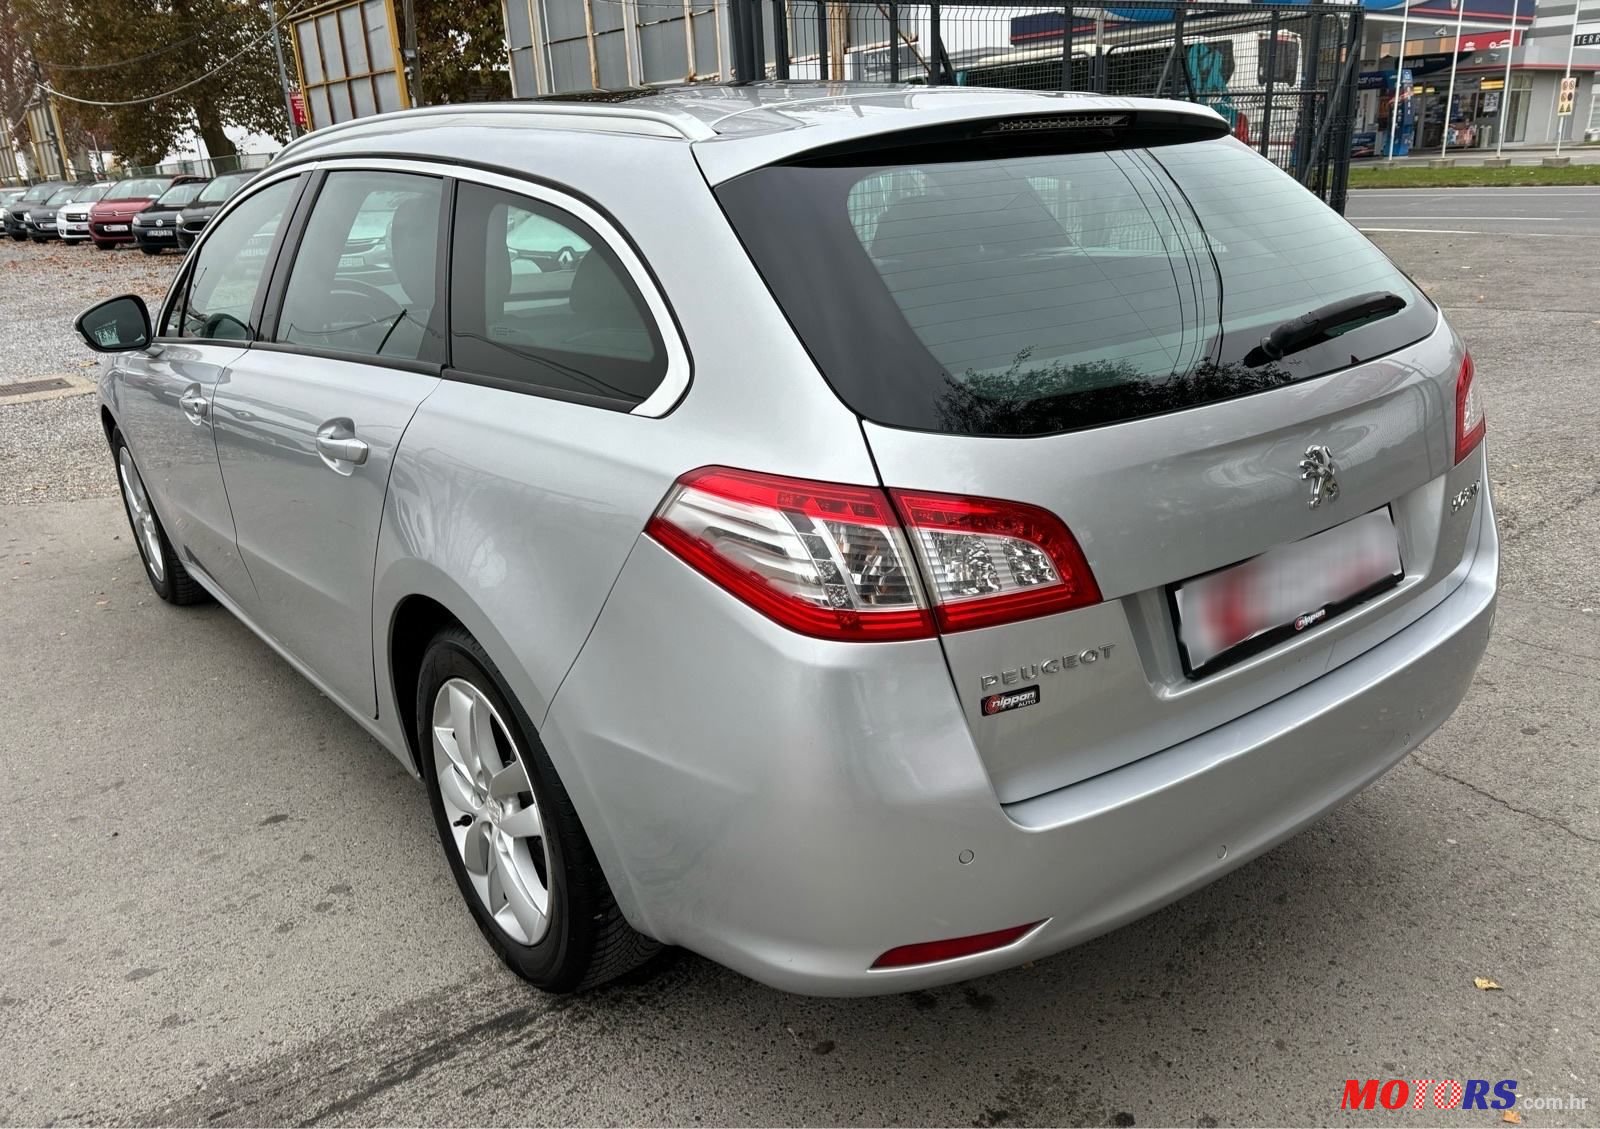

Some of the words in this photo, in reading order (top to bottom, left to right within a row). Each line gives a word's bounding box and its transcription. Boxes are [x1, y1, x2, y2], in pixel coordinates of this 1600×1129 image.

[980, 643, 1116, 690] PEUGEOT
[991, 691, 1035, 708] nippon
[1018, 699, 1036, 708] AUTO
